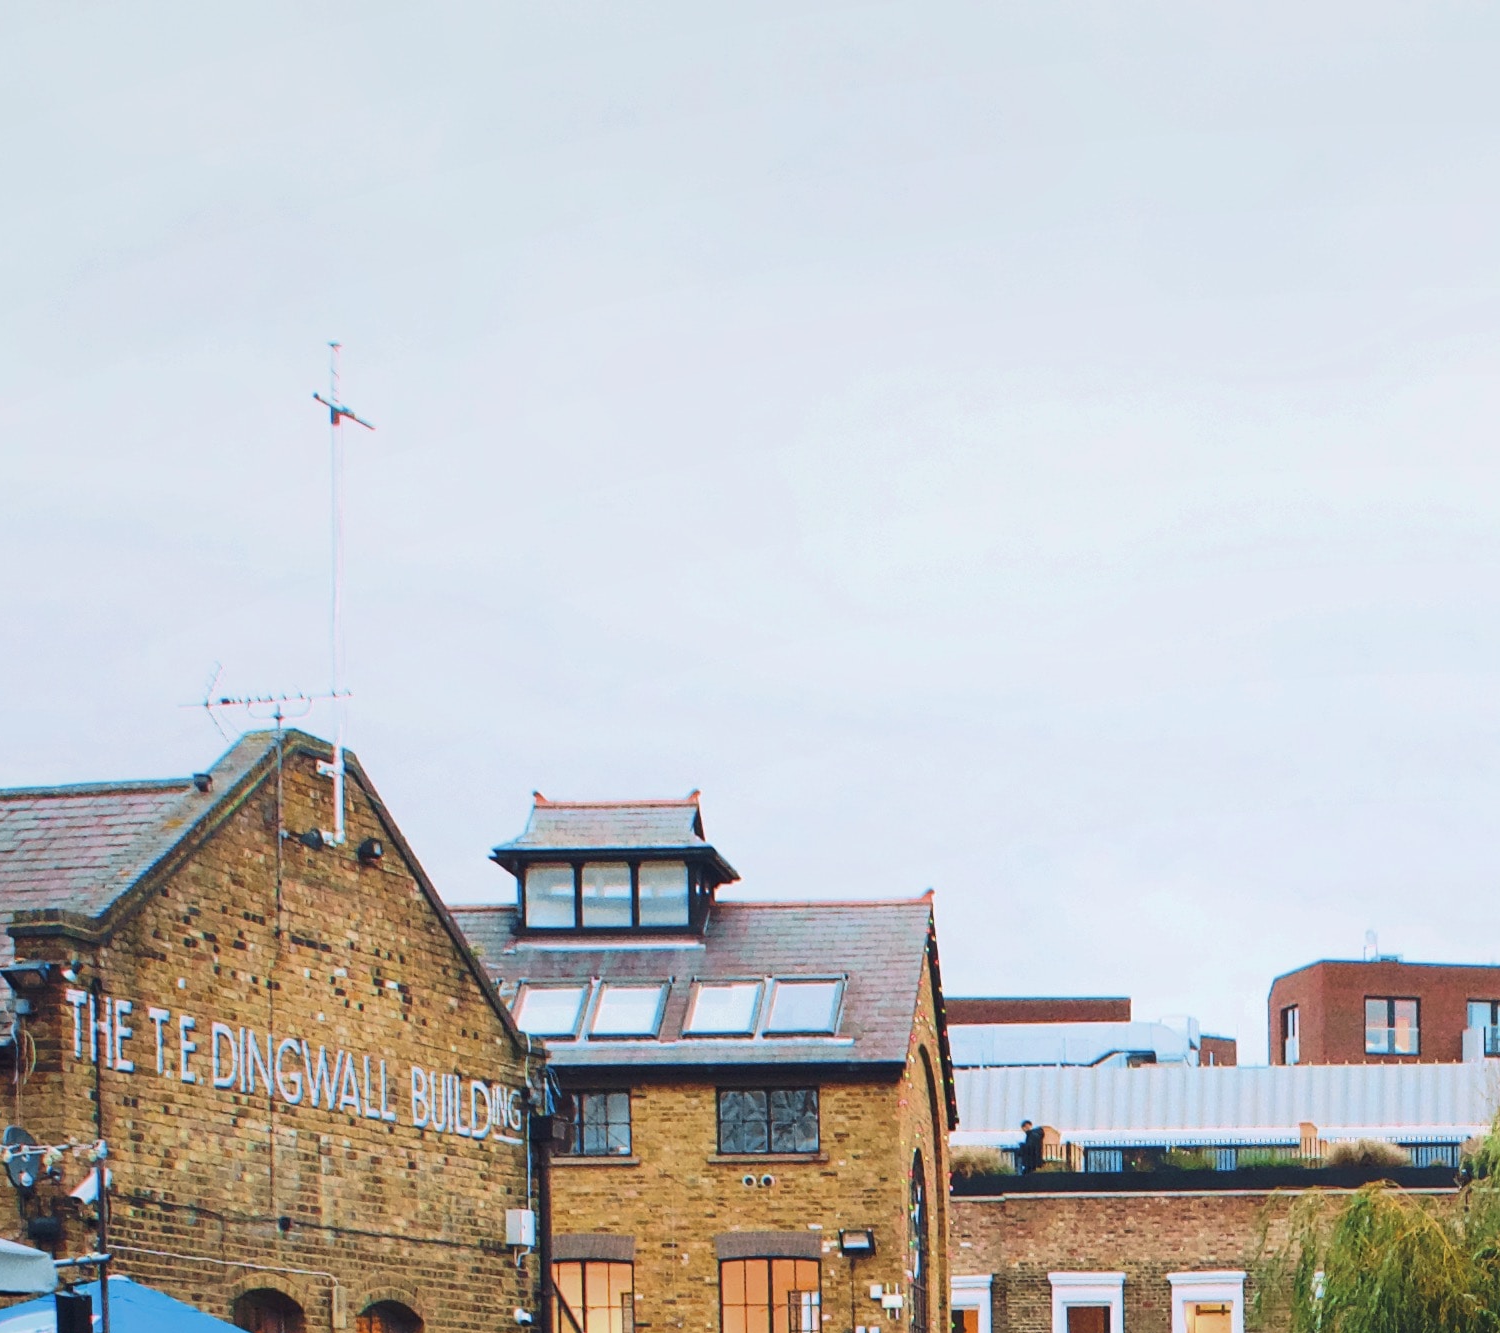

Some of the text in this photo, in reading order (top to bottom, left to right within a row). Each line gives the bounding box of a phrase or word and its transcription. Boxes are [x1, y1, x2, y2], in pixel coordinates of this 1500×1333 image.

[65, 988, 523, 1141] THE T.E. DINGWALL BUILDING
